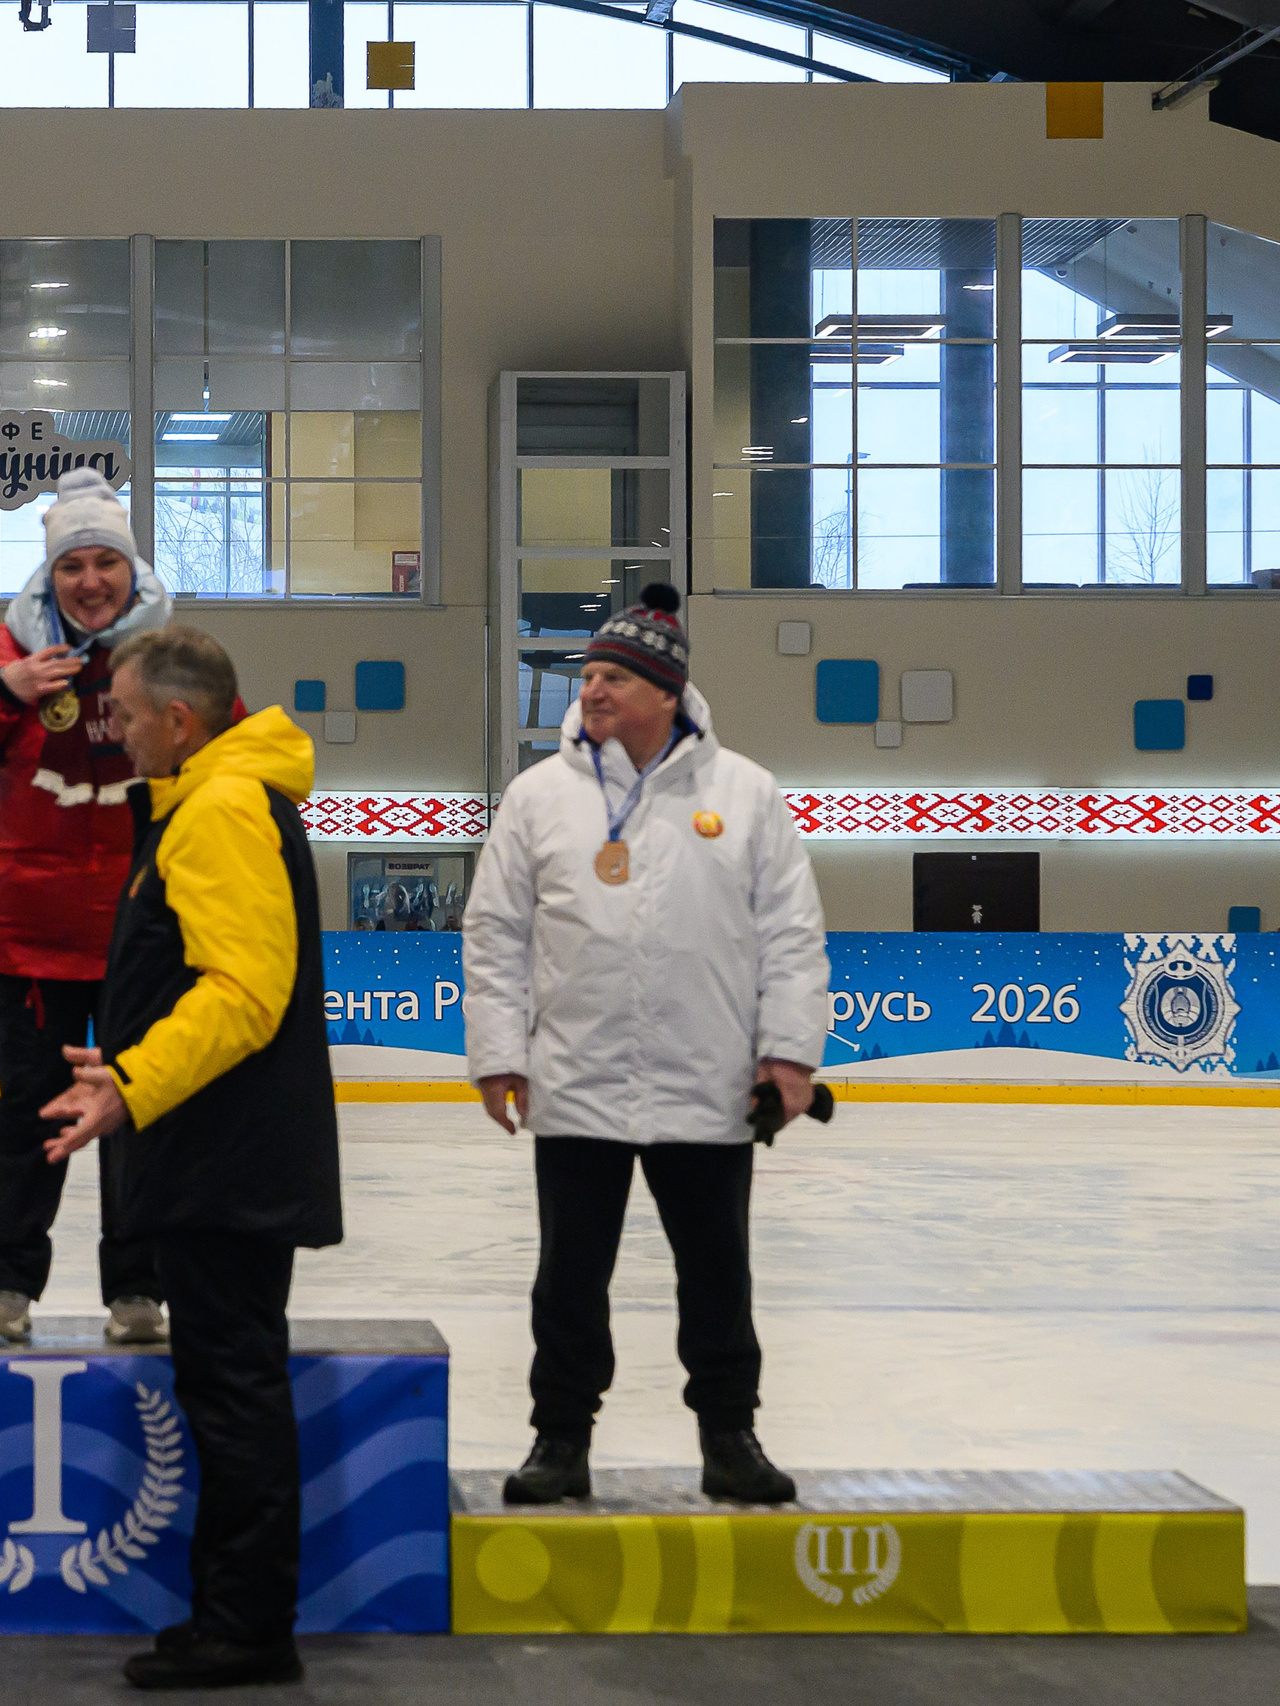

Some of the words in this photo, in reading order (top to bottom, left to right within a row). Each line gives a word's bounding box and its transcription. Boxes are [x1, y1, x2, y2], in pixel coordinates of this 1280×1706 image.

[433, 980, 466, 1021] Р
[825, 989, 932, 1033] русь
[970, 983, 1081, 1023] 2026
[7, 1360, 88, 1534] I
[816, 1526, 884, 1574] III
